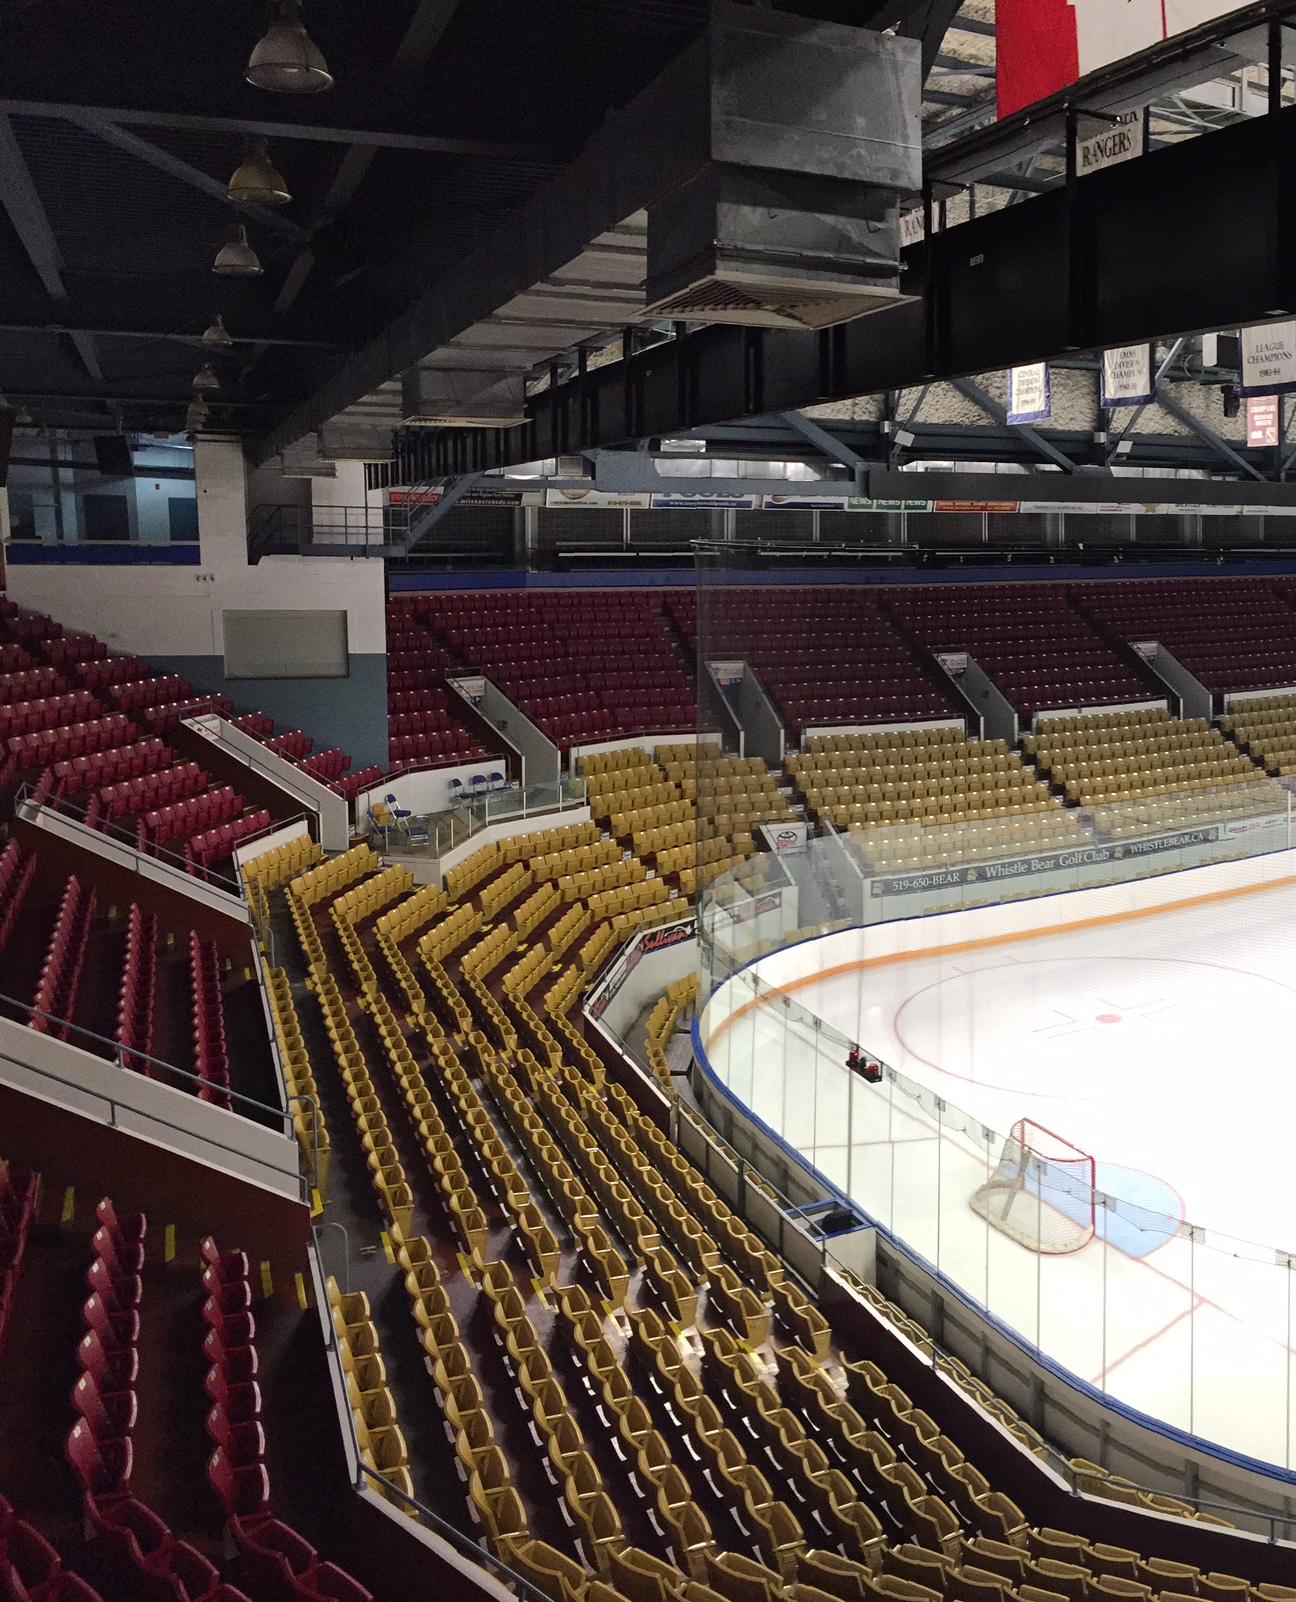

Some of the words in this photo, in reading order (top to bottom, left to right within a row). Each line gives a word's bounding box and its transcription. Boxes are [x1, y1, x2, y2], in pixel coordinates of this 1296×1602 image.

[1082, 128, 1132, 167] RANGERS
[1246, 351, 1293, 364] CHAMPIONS
[1256, 341, 1285, 353] LEAGUE
[892, 873, 960, 891] 519-650-BEAR
[985, 861, 1028, 878] Whistle
[1031, 859, 1055, 871] Bear
[1059, 852, 1083, 867] Golf
[1083, 849, 1110, 863] Club
[1130, 832, 1204, 853] WHISTLEBEAR.CA
